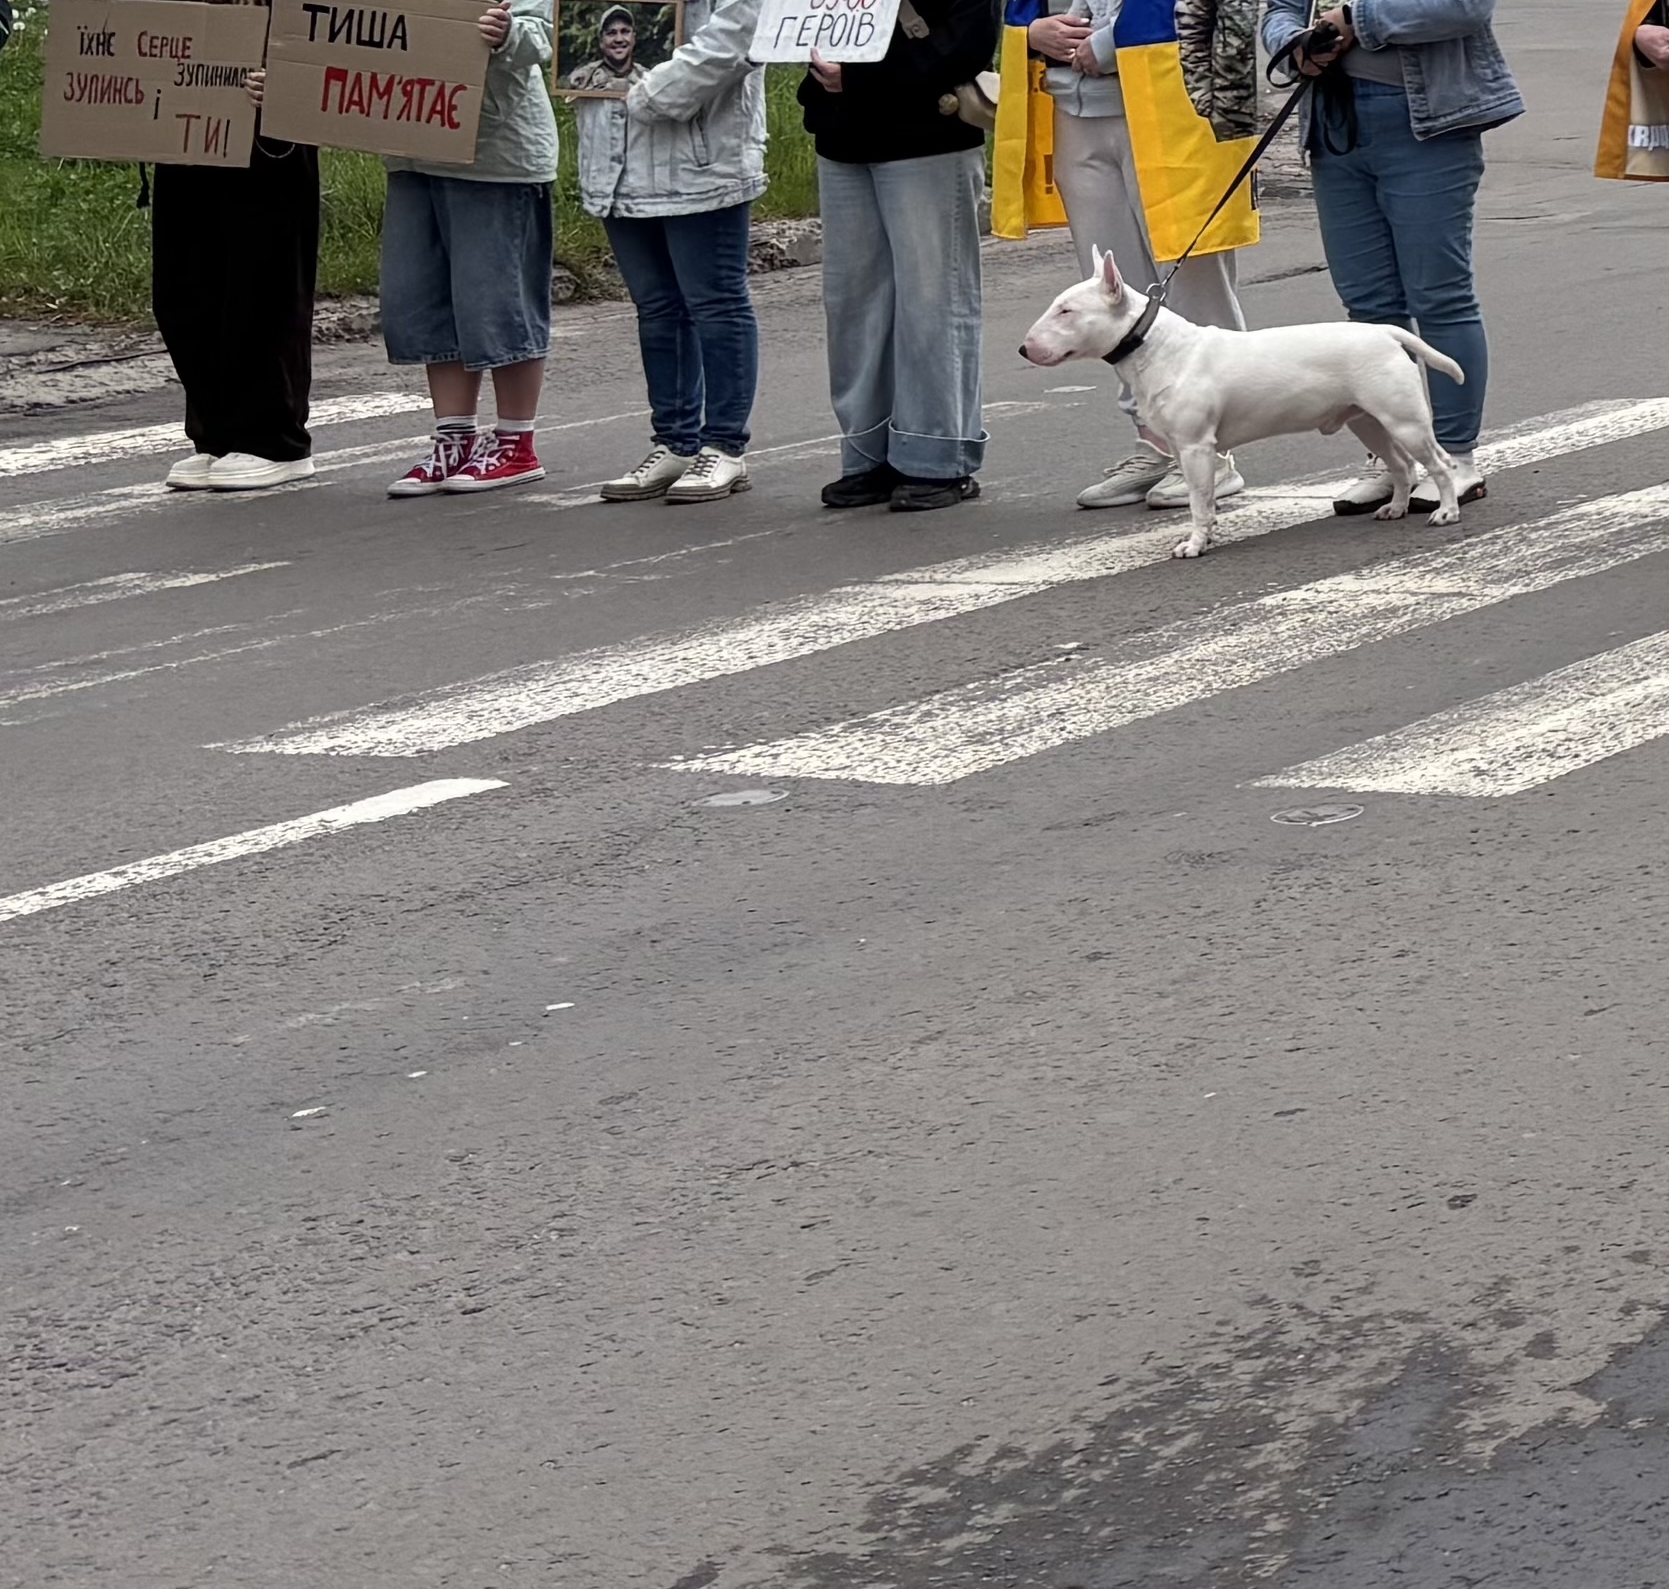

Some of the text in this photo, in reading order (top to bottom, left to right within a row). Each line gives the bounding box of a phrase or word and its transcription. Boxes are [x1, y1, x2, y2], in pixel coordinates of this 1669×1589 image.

[302, 3, 408, 51] ТИША
[774, 9, 875, 49] ГЕРОЇВ
[63, 72, 145, 105] ЗУПИНСЬ
[174, 62, 255, 89] ЗУПИНИЛО
[321, 66, 468, 130] ПАМ'ЯТАЄ
[176, 113, 231, 158] ТИ!
